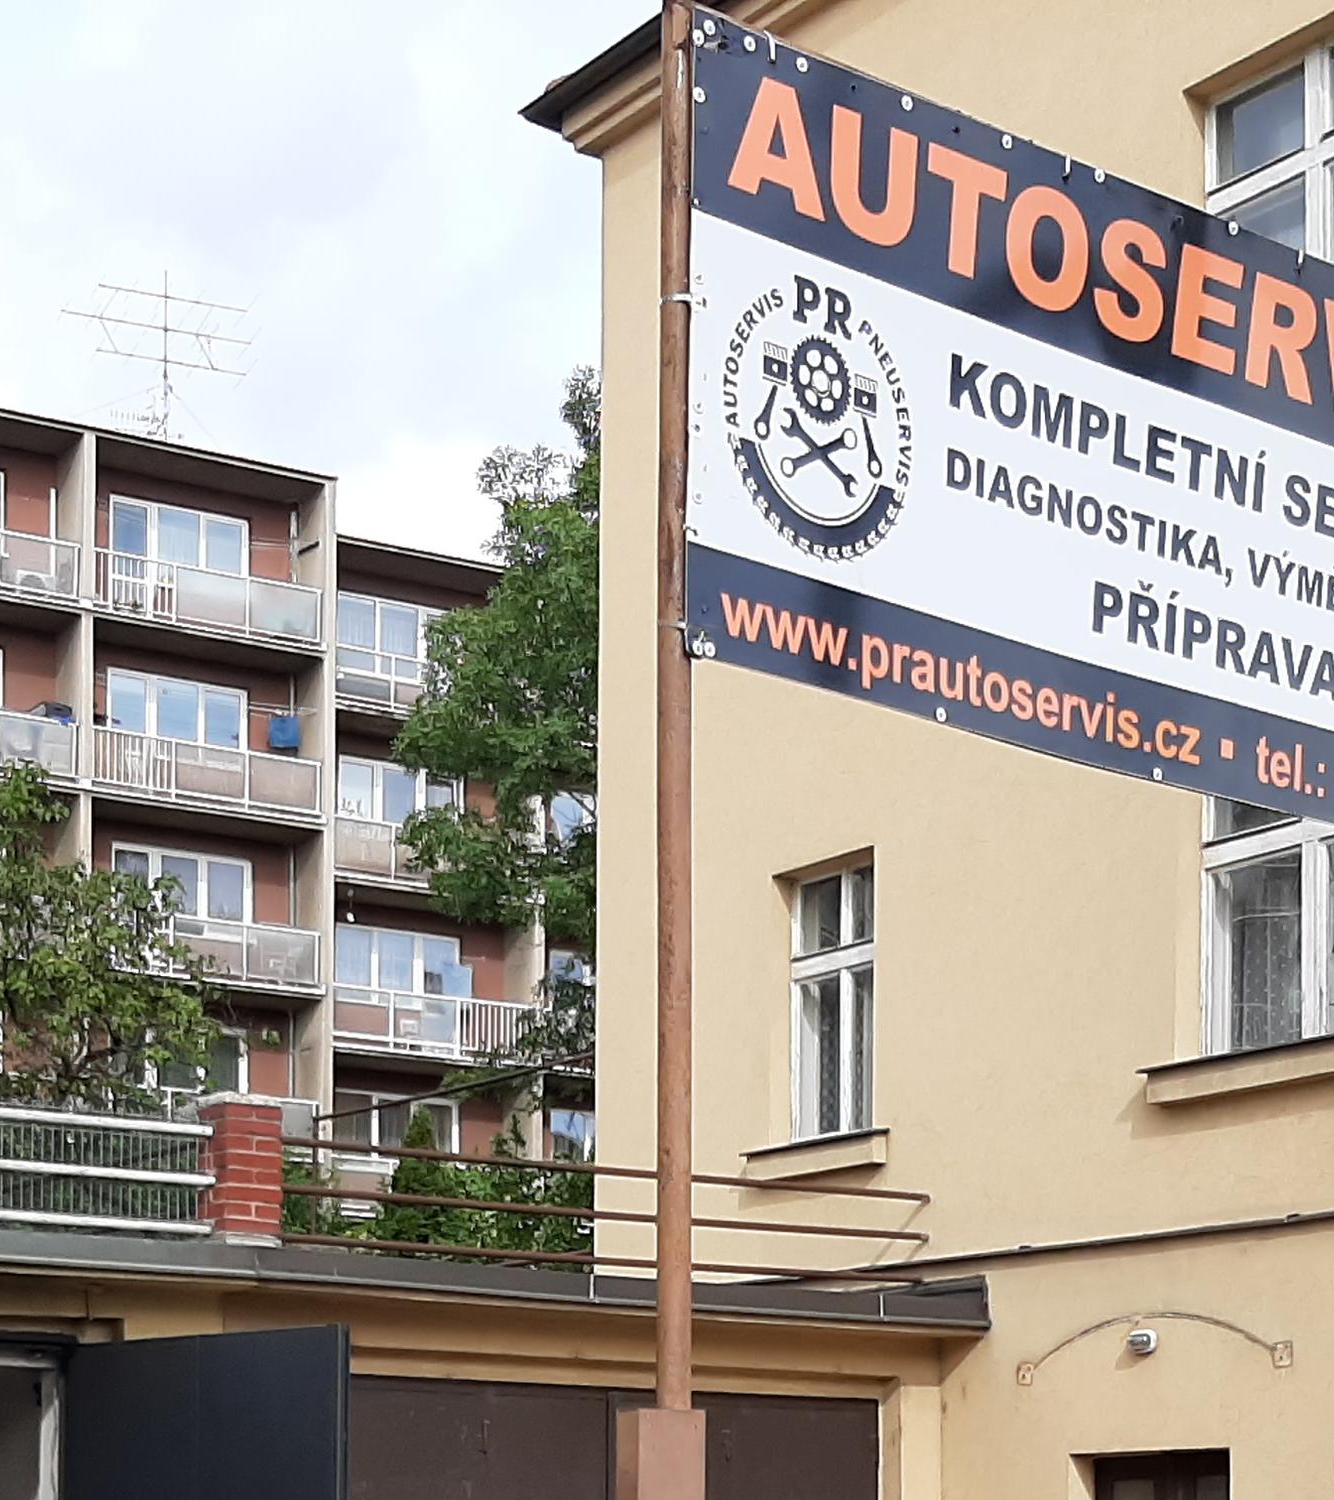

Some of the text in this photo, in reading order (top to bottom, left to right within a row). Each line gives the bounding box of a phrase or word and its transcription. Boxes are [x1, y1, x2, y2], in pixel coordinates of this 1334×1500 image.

[723, 288, 784, 428] AUTOSERVIS
[792, 274, 853, 341] PR
[858, 319, 913, 487] PNEUSERVIS
[948, 352, 1267, 513] KOMPLETNÍ
[946, 447, 1234, 588] DIAGNOSTIKA,
[720, 592, 1202, 765] www.prautoservis.cz
[1255, 736, 1327, 798] tel.:
